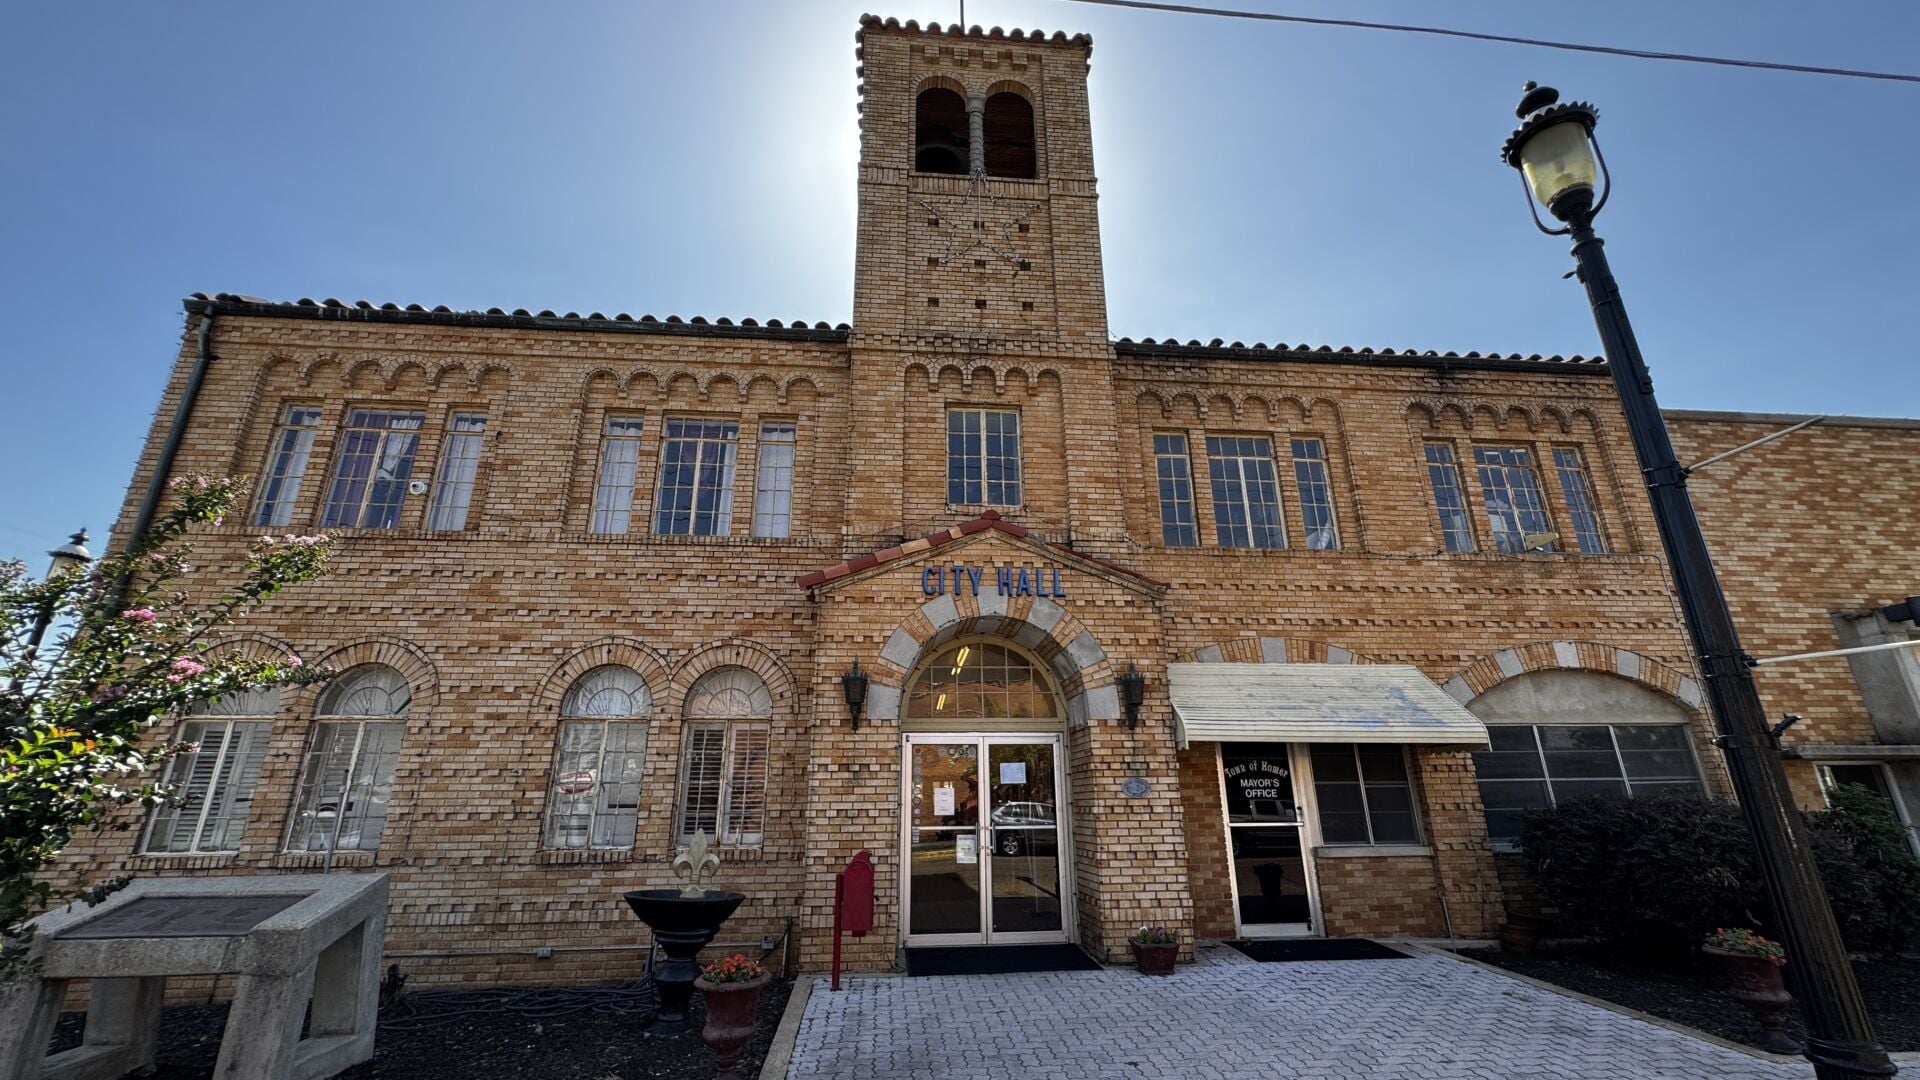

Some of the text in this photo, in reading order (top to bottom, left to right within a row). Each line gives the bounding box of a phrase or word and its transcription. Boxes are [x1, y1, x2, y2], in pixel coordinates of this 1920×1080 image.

[922, 566, 1066, 597] CITY HALL
[1224, 760, 1288, 778] Town of Homer
[1240, 779, 1279, 787] MAYOR'S
[1245, 789, 1278, 797] OFFICE
